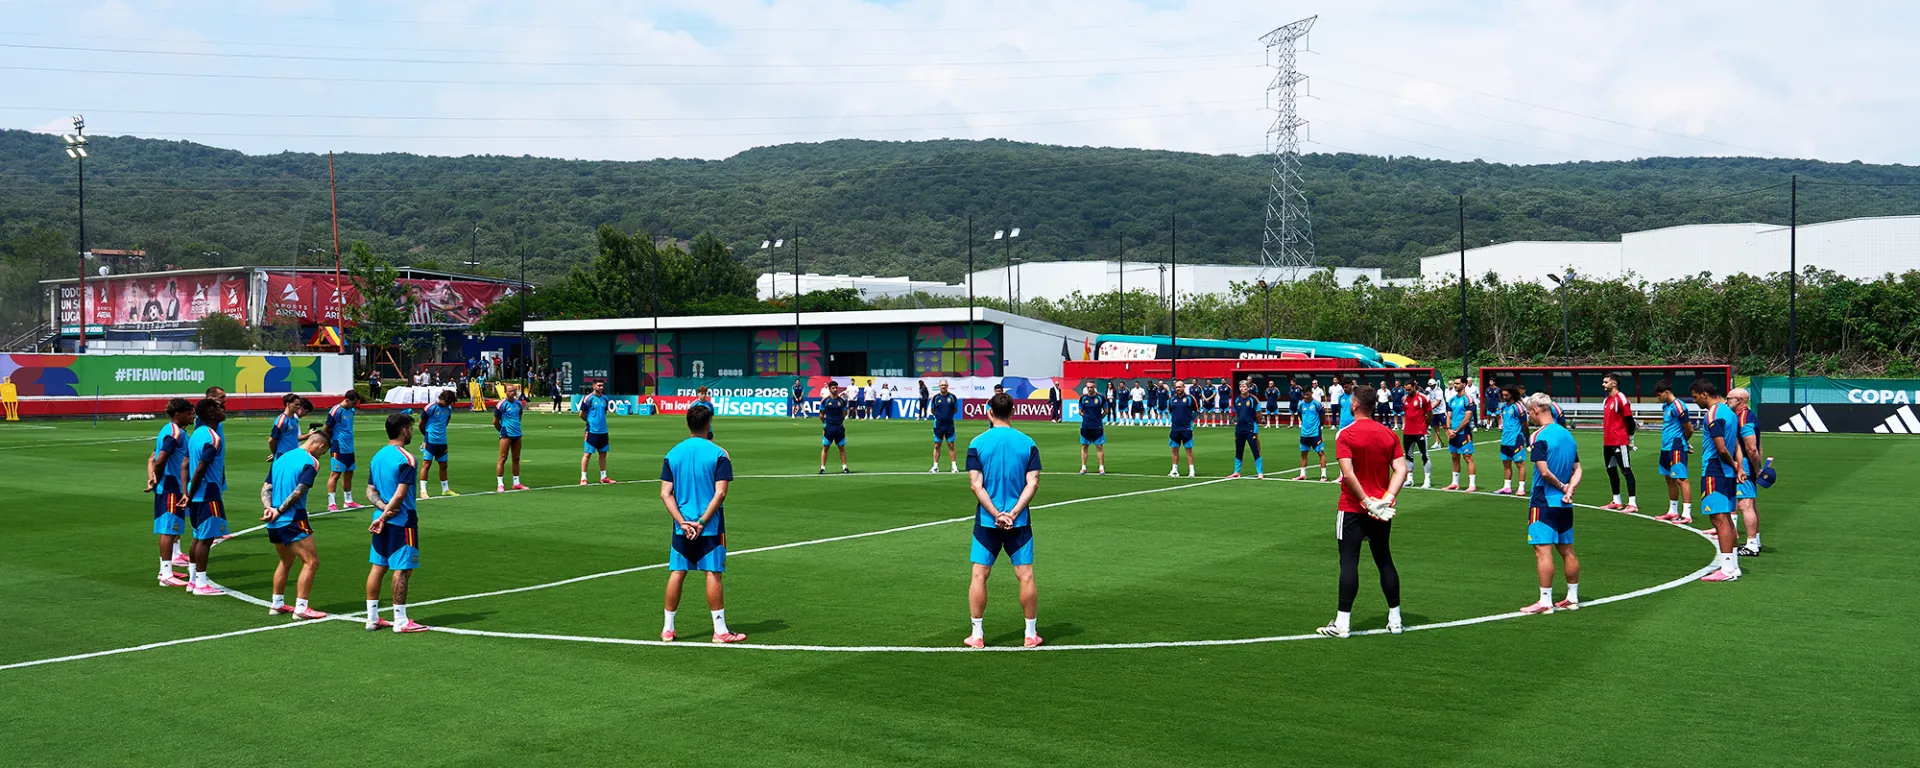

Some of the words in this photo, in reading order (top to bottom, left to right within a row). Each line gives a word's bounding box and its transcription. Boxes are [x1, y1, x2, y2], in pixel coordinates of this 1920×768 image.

[61, 287, 80, 298] TODO
[61, 299, 72, 310] UN
[275, 303, 308, 311] SPORTS
[61, 311, 81, 322] LUGA
[275, 309, 308, 318] ARENA
[114, 368, 205, 383] #FIFAWorldCup
[677, 388, 697, 397] FIFA
[706, 388, 732, 397] ORLD
[733, 388, 754, 397] CUP
[754, 388, 789, 397] 2026
[1848, 388, 1910, 405] COPA
[660, 399, 673, 410] i'm
[674, 399, 691, 410] lovi
[711, 397, 787, 416] Hisense
[964, 403, 987, 418] QAT
[1013, 403, 1059, 416] IRWAY
